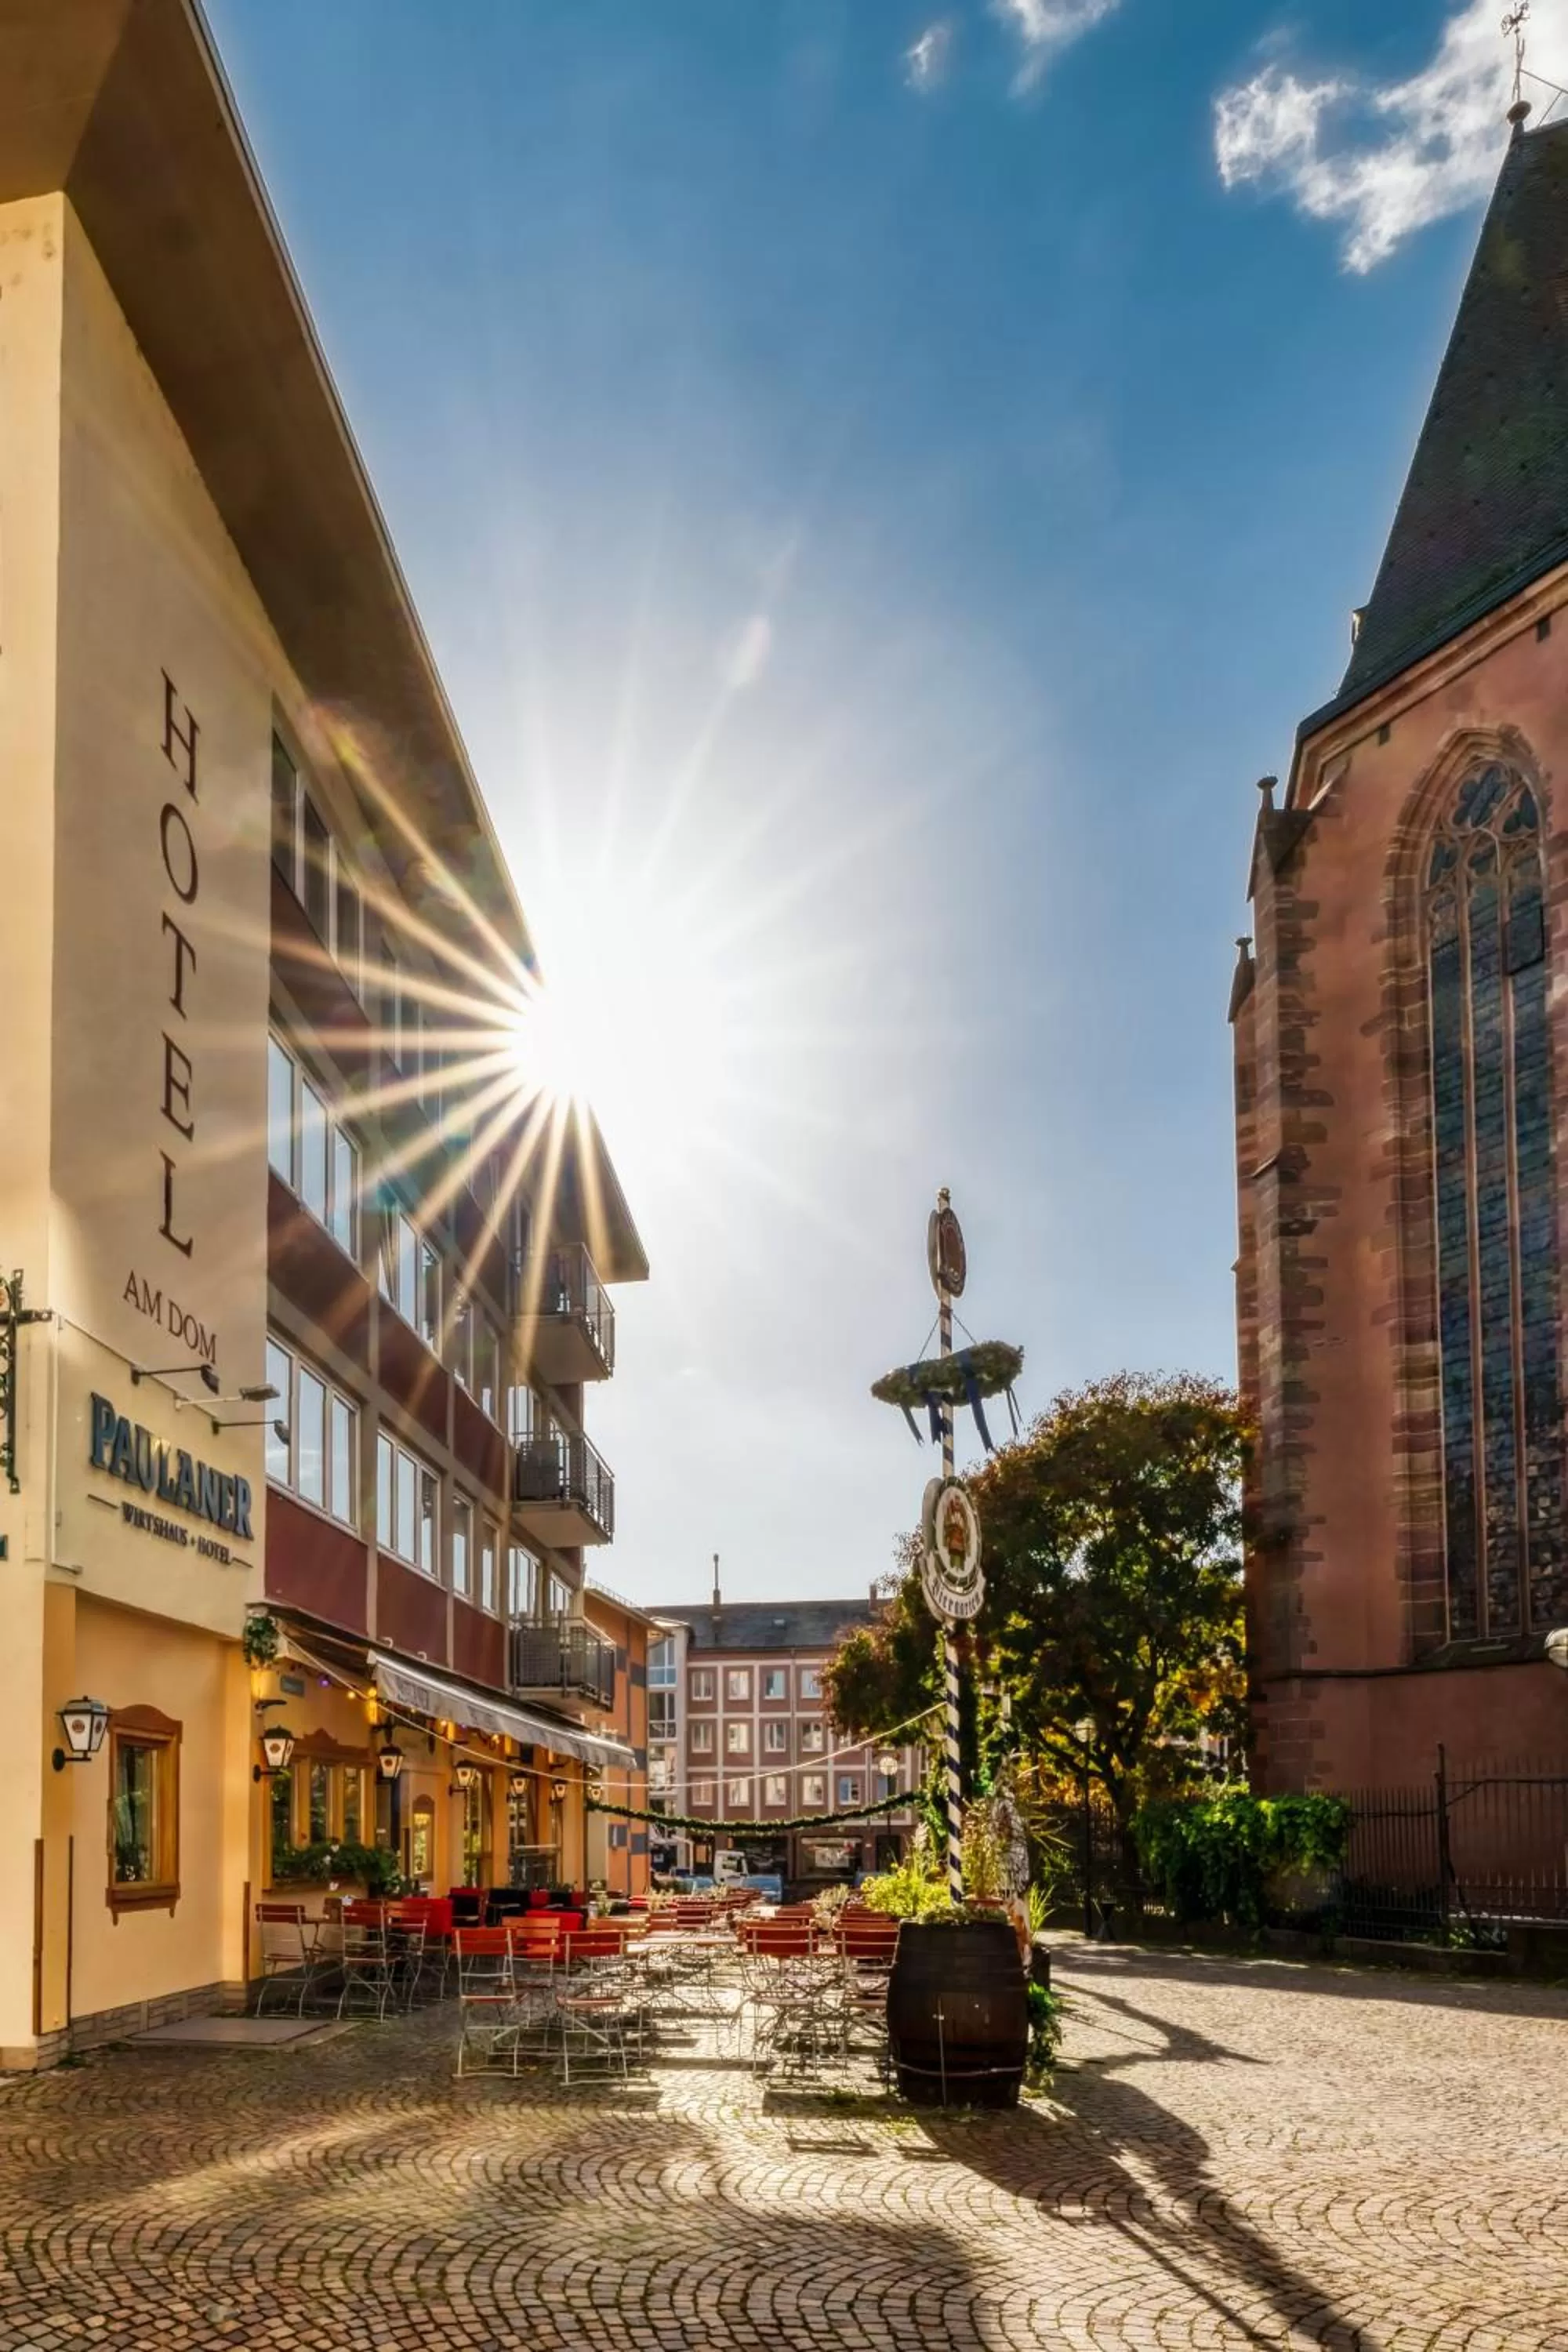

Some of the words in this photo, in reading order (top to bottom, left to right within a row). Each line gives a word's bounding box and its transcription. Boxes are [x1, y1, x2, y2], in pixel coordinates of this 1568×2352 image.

[161, 666, 201, 1258] HOTEL
[123, 1269, 162, 1325] AM
[168, 1298, 216, 1364] DOM
[90, 1392, 254, 1542] PAULANER
[198, 1535, 234, 1566] HOTEL
